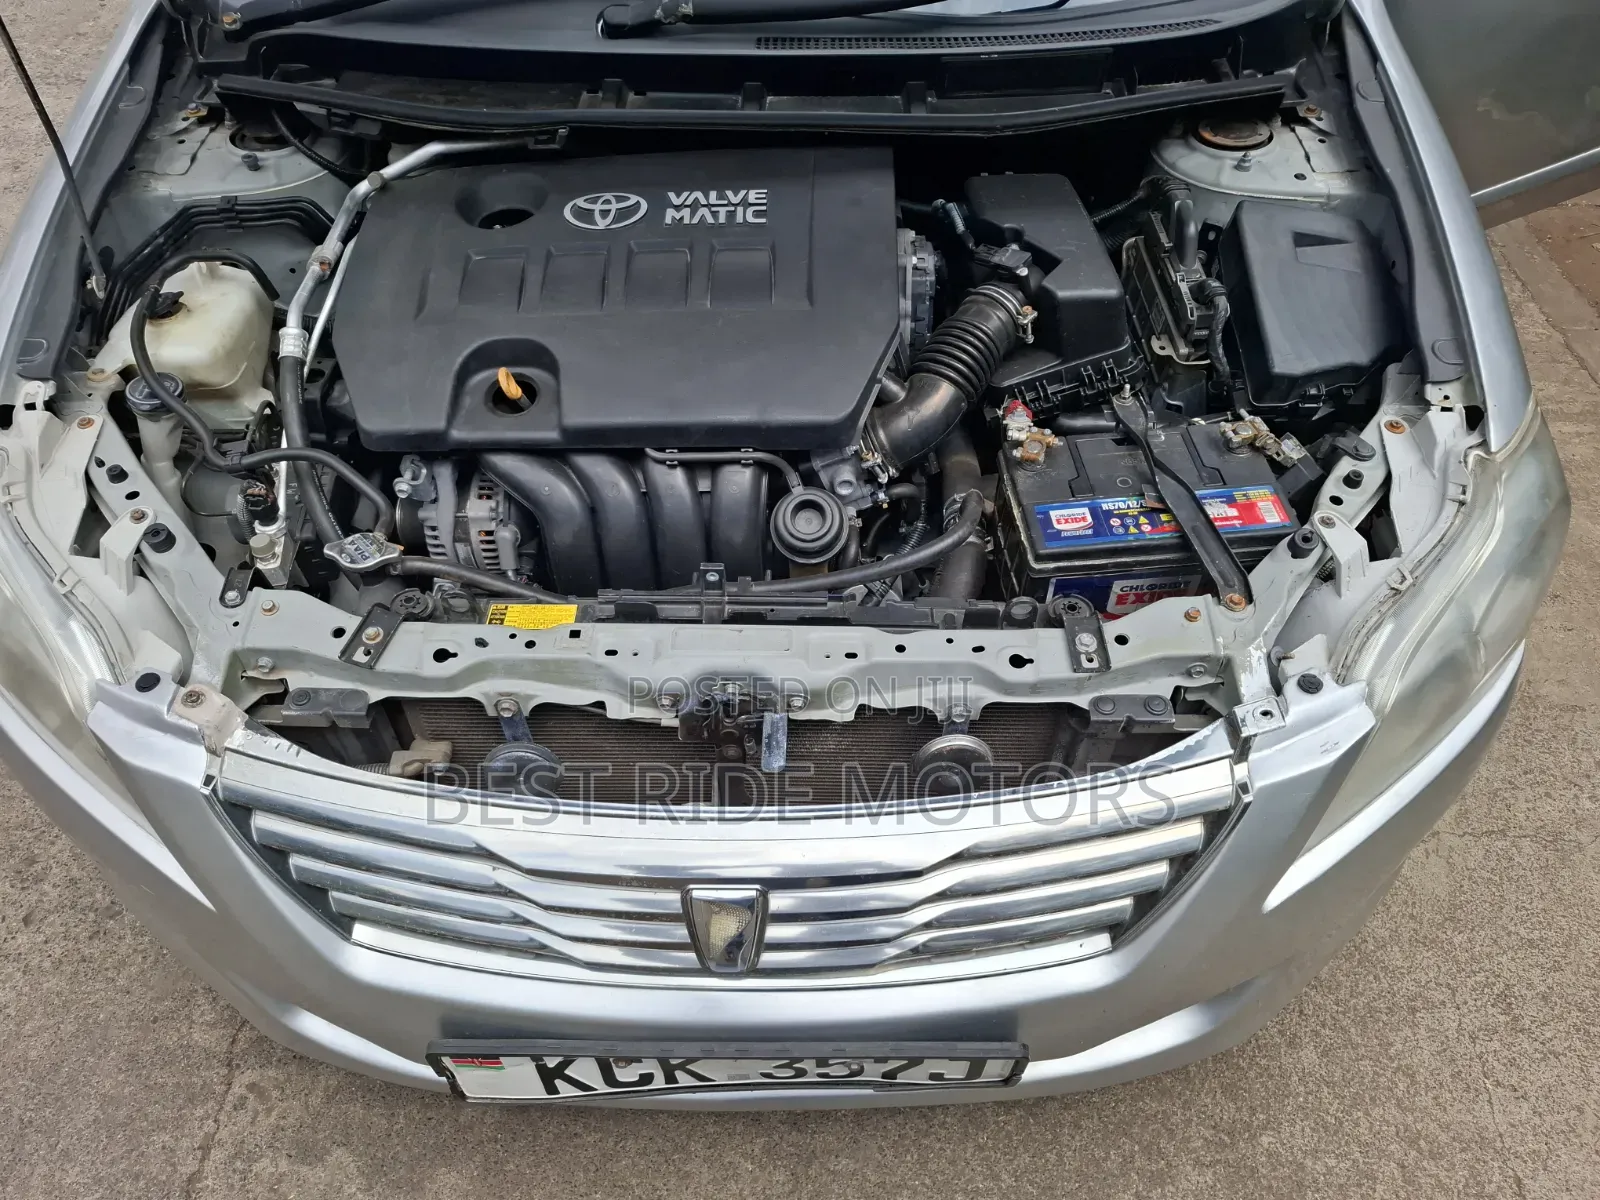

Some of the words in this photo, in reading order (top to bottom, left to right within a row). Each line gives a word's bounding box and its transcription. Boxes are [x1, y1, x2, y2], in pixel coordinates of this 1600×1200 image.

[667, 189, 768, 206] VALVE
[664, 207, 767, 225] MATIC
[1056, 516, 1088, 525] EXIDE
[348, 539, 371, 562] PIAA
[530, 1056, 717, 1095] KCK
[759, 1058, 987, 1082] 357J
